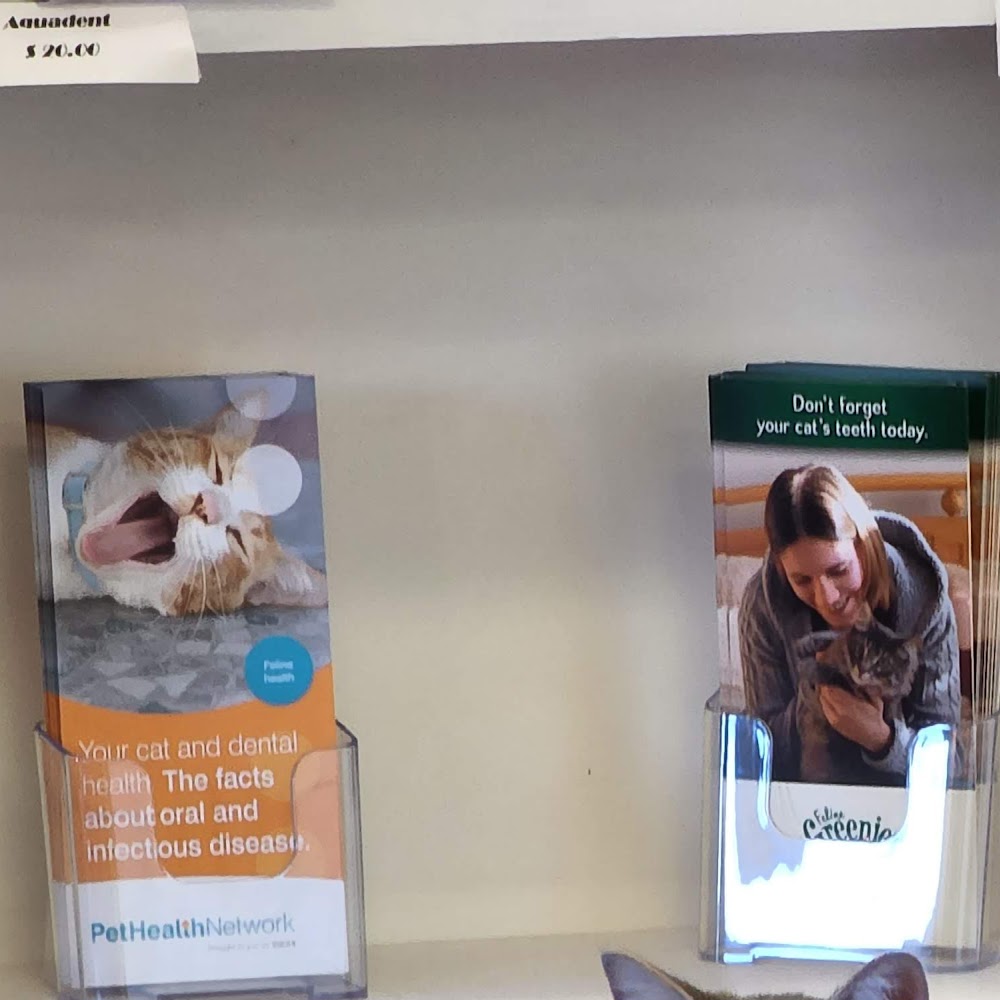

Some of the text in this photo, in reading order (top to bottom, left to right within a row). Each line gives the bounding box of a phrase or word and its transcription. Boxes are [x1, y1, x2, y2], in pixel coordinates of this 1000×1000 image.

[3, 13, 111, 30] Aquadent
[25, 42, 101, 59] $ 20.00
[792, 393, 888, 421] Don't forget
[756, 417, 928, 444] your cat's teeth today.
[78, 730, 298, 761] Your cat and dental
[82, 767, 275, 796] health The facts
[84, 798, 259, 830] about oral and
[87, 832, 310, 863] infectious disease.
[91, 912, 295, 944] PetHealthNetwork
